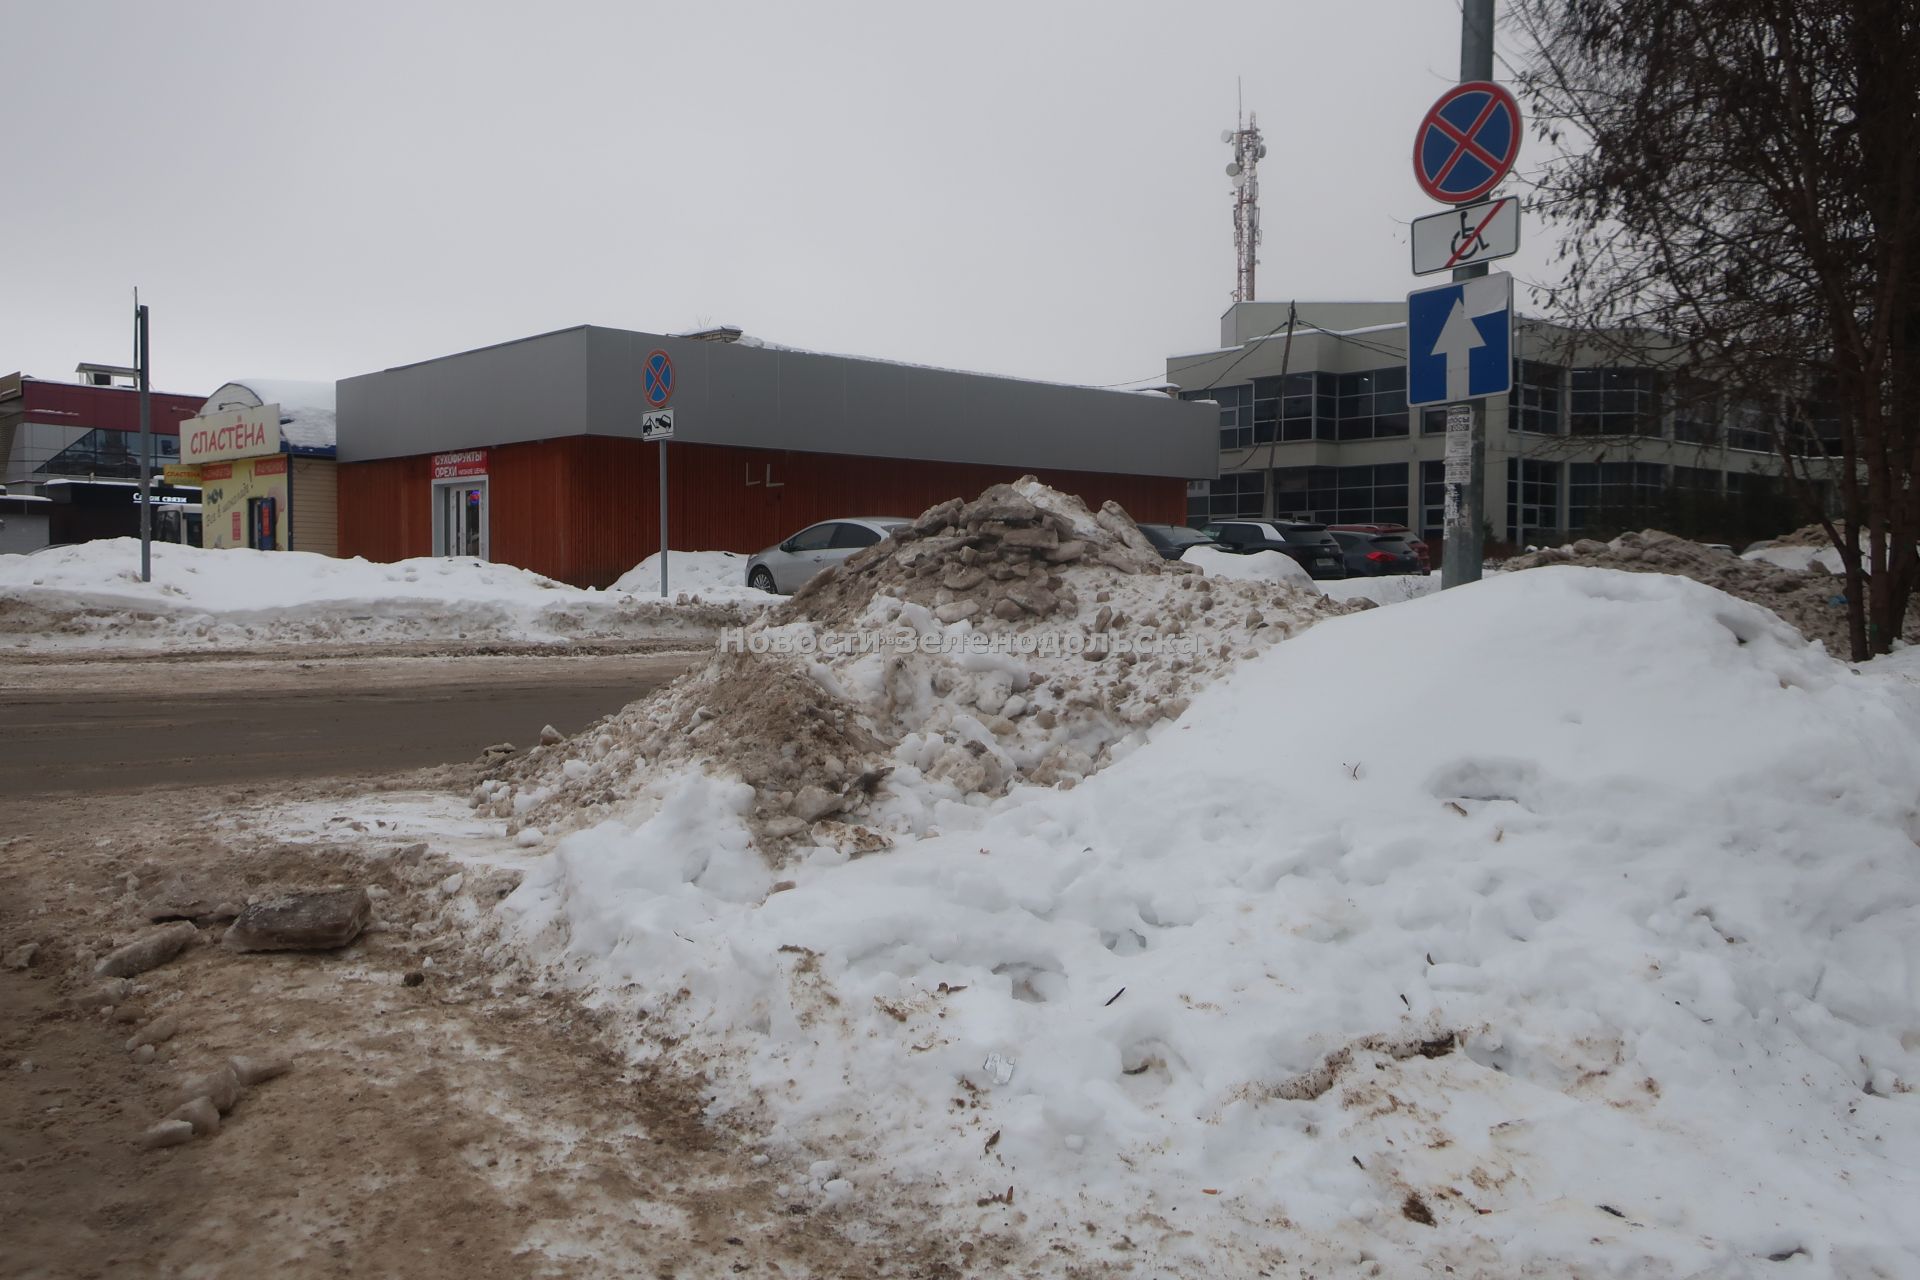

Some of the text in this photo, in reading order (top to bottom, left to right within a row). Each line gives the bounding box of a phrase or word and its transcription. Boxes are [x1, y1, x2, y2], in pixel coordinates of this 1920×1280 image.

[190, 416, 266, 455] СЛАСТЁНА
[434, 451, 482, 465] СУХОФРУКТЫ
[434, 466, 457, 478] ОРЕХИ
